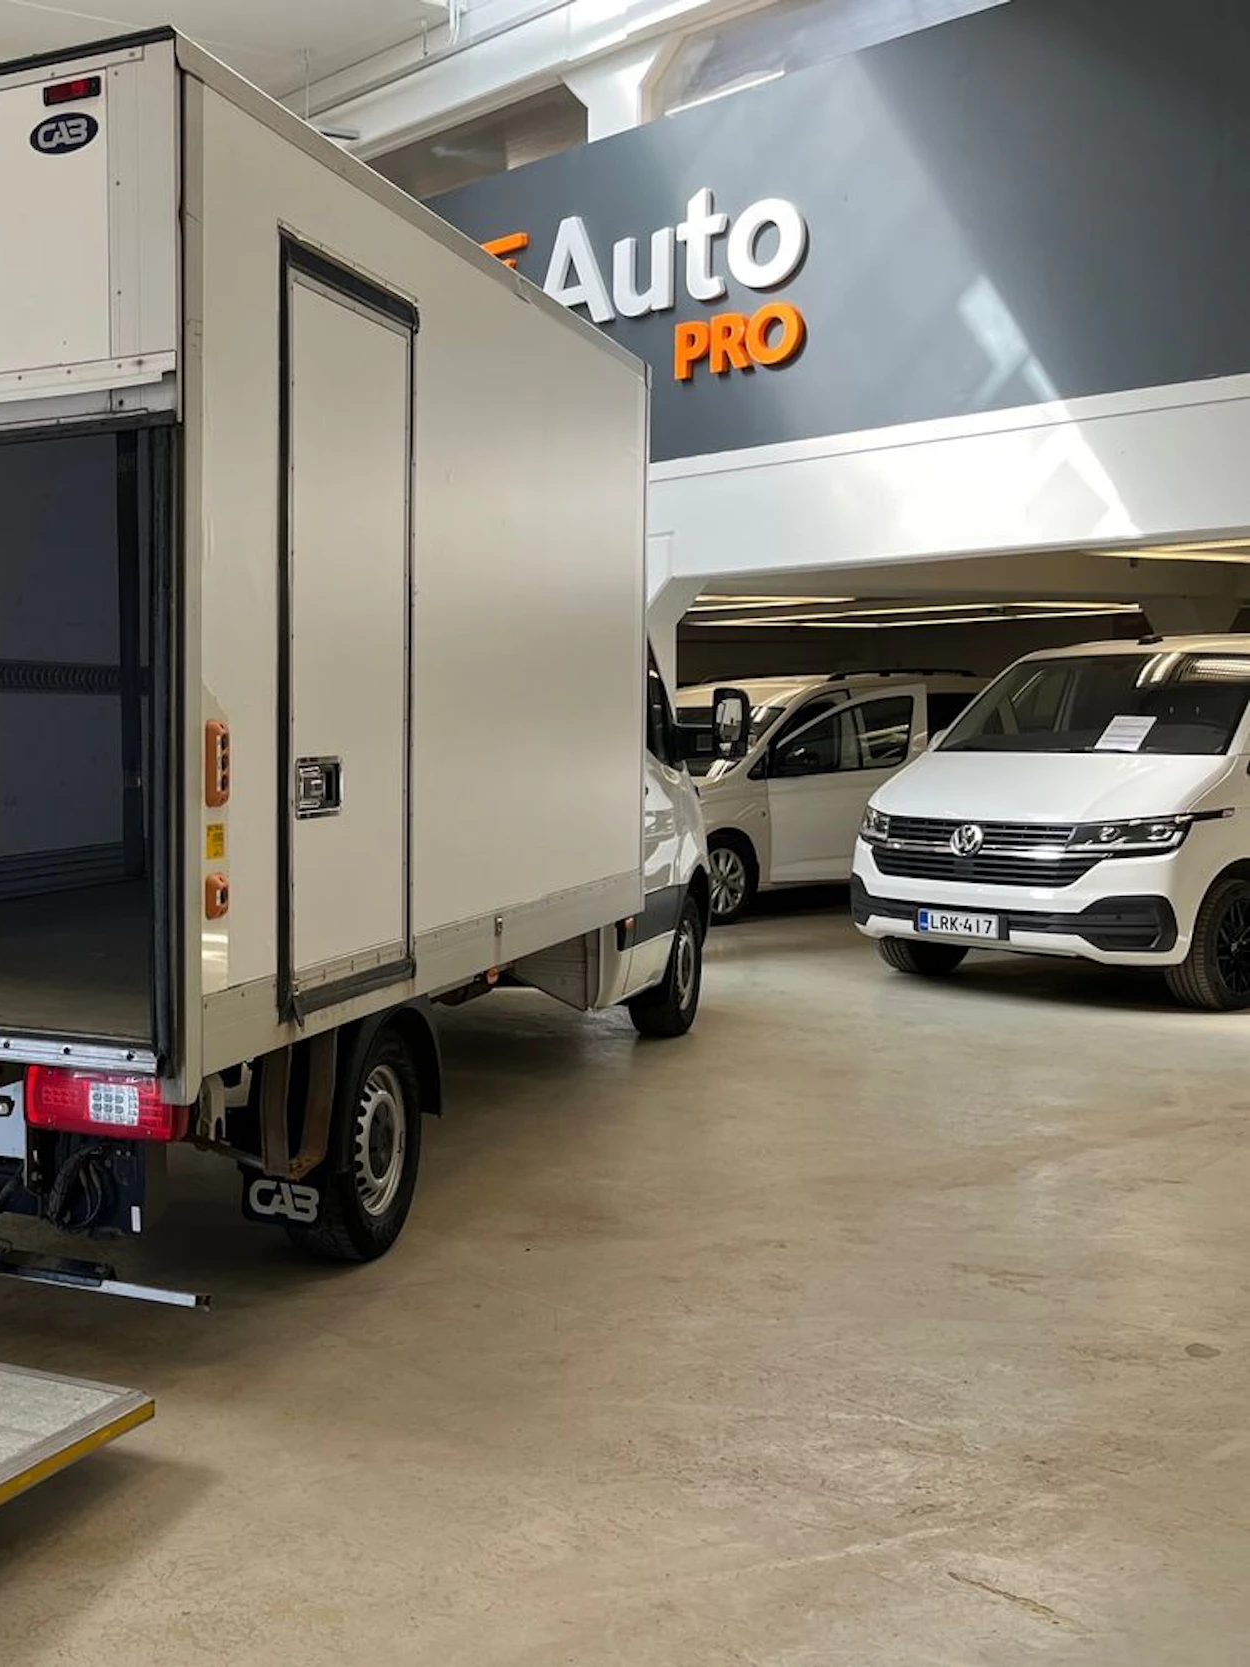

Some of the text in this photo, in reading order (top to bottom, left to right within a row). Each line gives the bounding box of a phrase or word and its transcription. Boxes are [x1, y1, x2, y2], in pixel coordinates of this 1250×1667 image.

[37, 117, 88, 149] CAB
[542, 186, 807, 324] Auto
[674, 302, 806, 381] PRO
[931, 915, 992, 934] LRK-417
[249, 1179, 319, 1223] CAB
